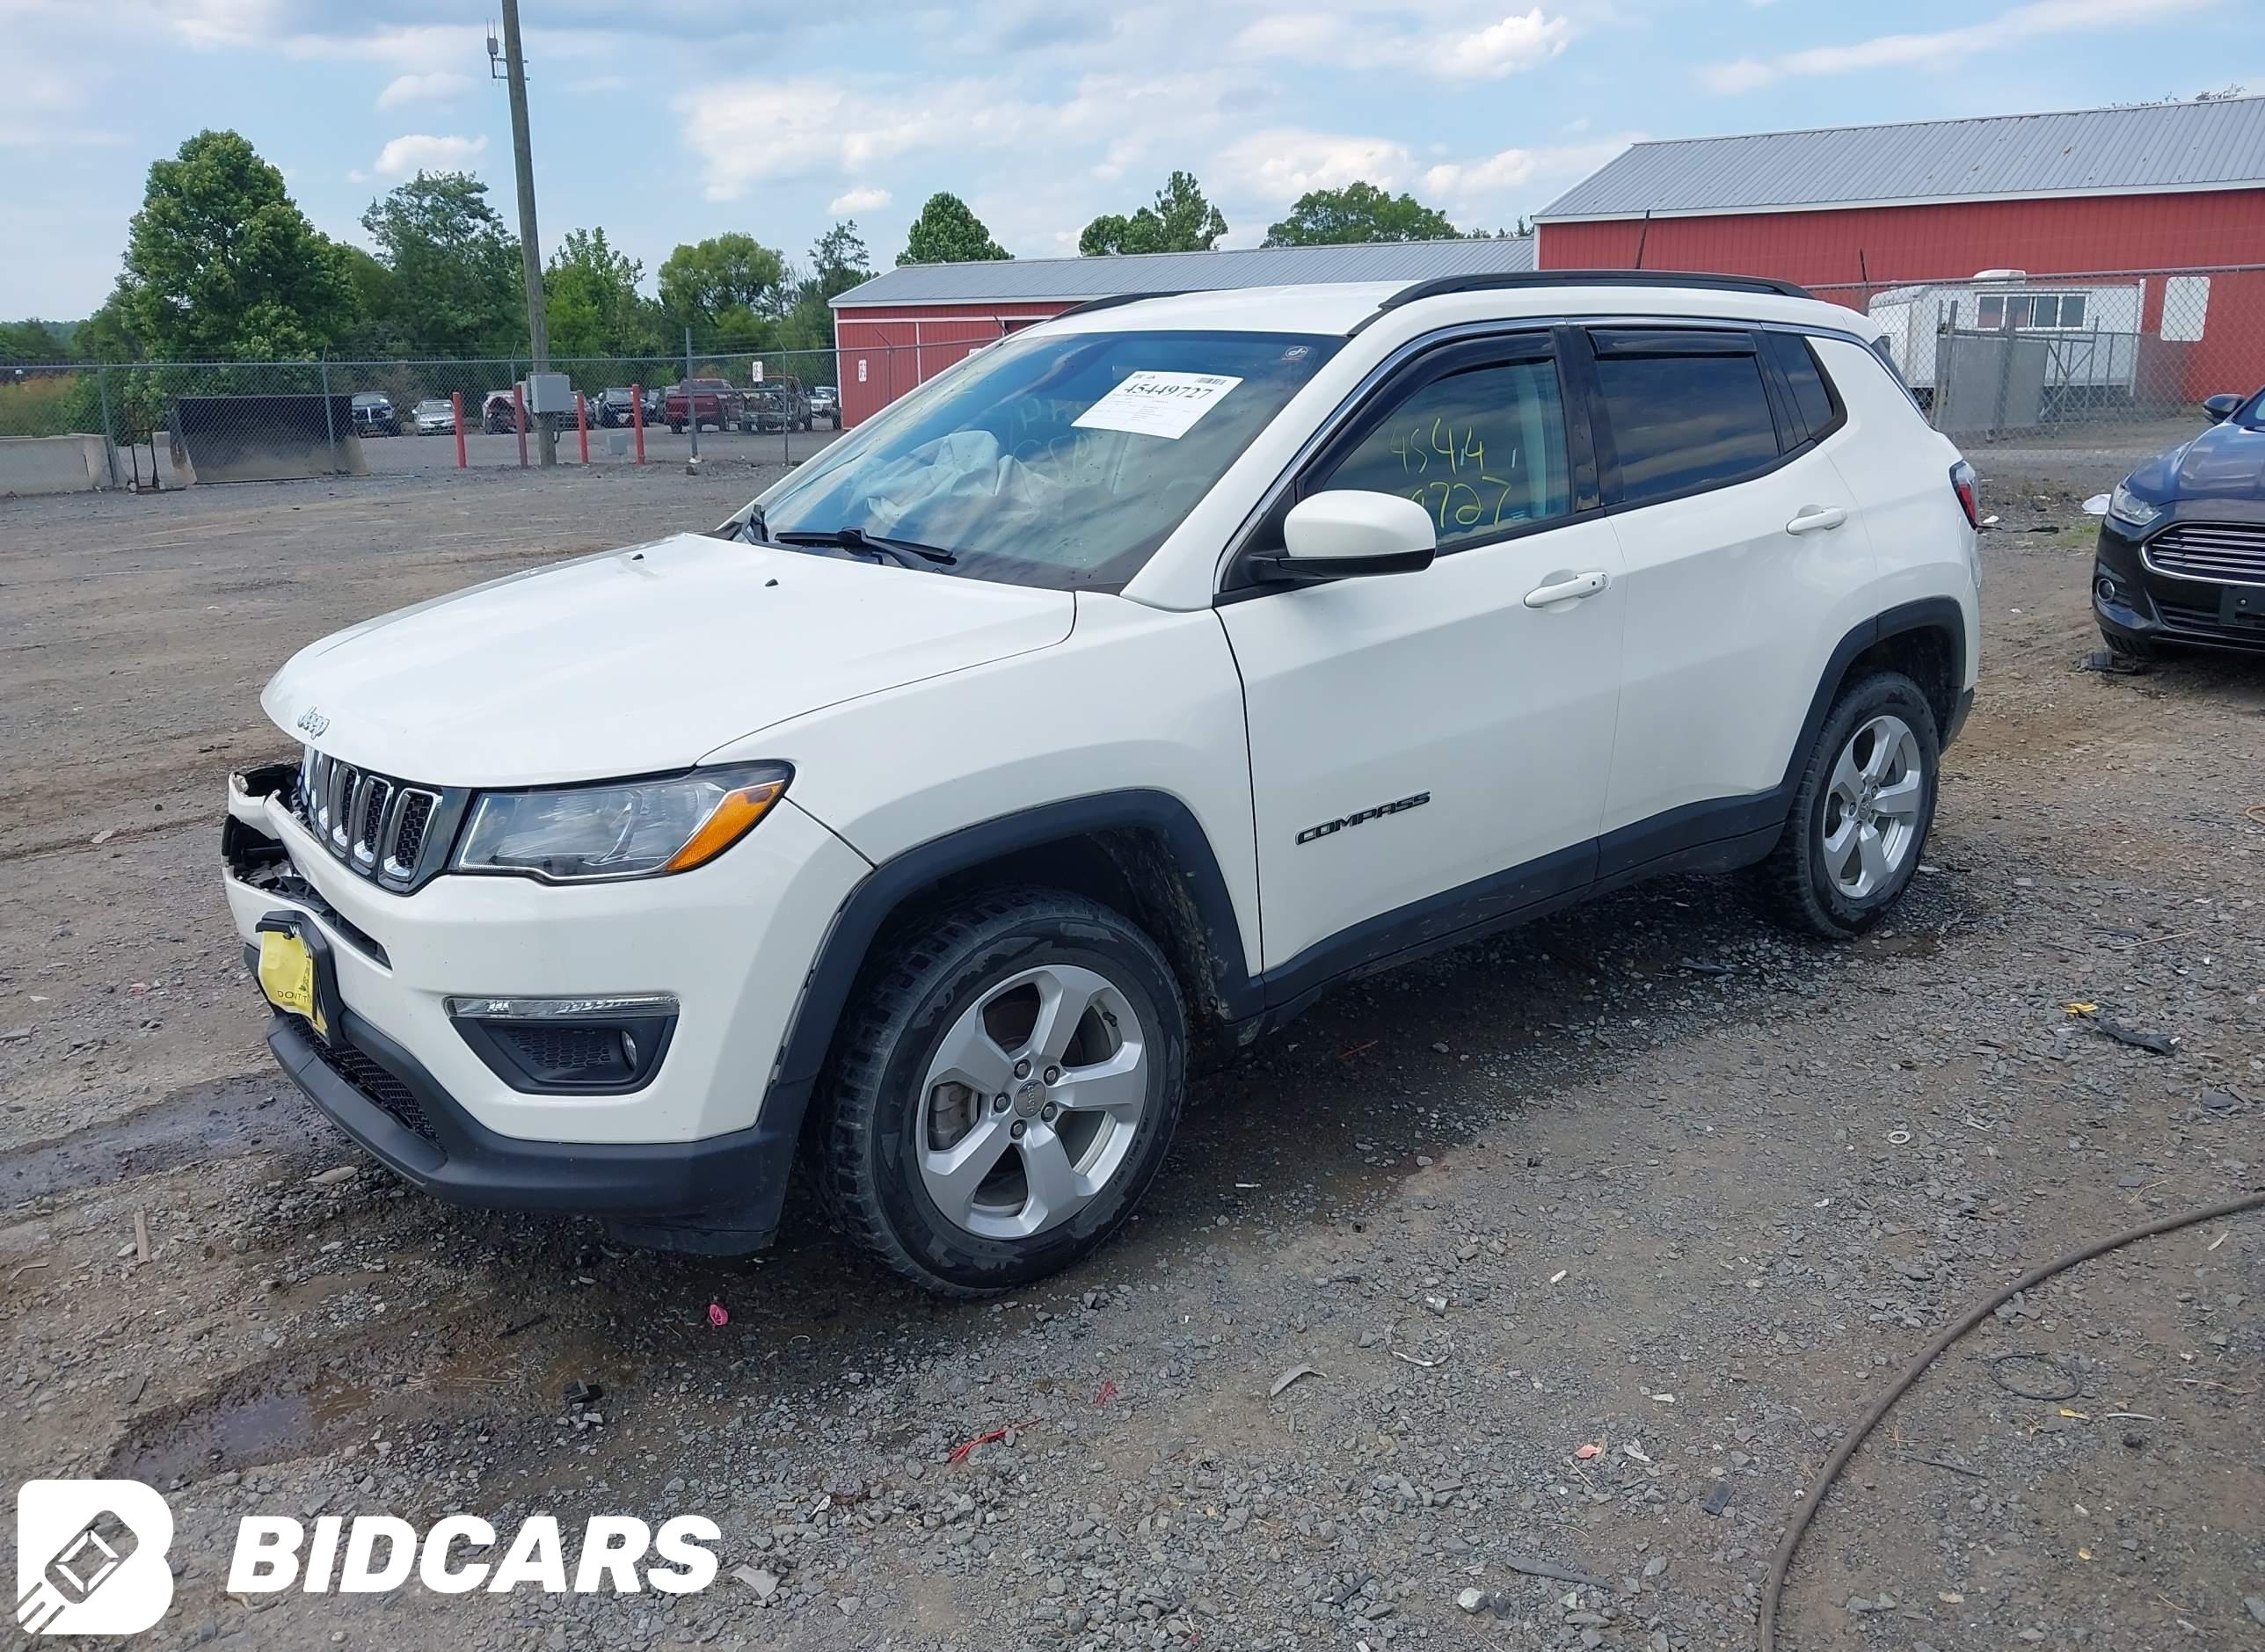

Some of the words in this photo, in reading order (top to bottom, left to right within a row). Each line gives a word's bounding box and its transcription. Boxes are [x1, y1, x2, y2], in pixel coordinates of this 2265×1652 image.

[1124, 382, 1216, 400] 45449727
[1388, 417, 1485, 476] 4544
[296, 705, 331, 740] Jeep
[1294, 790, 1431, 846] COMPASS
